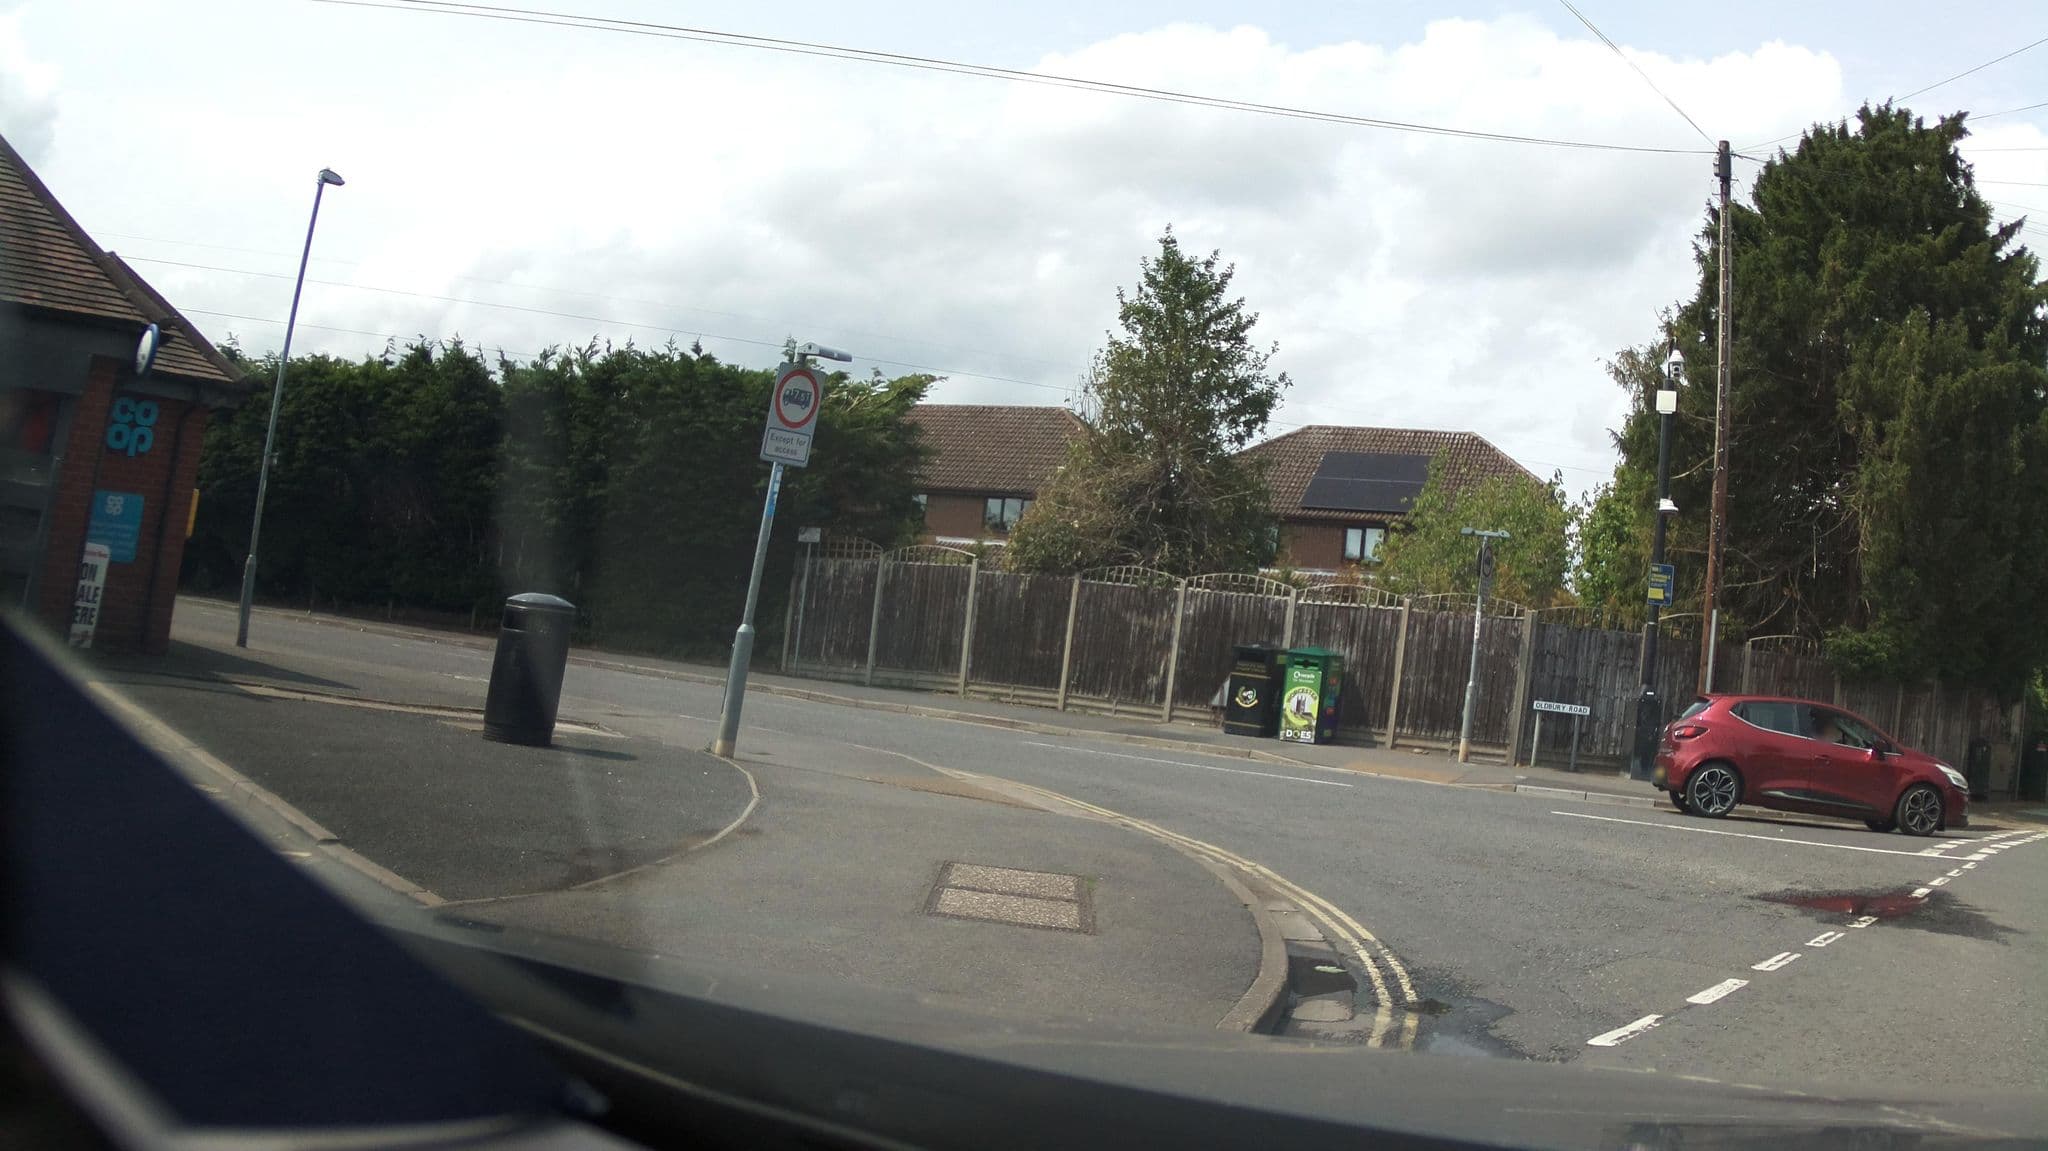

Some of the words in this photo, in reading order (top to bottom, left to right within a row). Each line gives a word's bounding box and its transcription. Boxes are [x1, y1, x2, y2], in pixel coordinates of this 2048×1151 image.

[770, 433, 794, 445] Except
[796, 437, 806, 446] for
[1535, 702, 1567, 711] OLDBURY
[1568, 705, 1588, 714] ROAD
[1286, 729, 1312, 739] DOES
